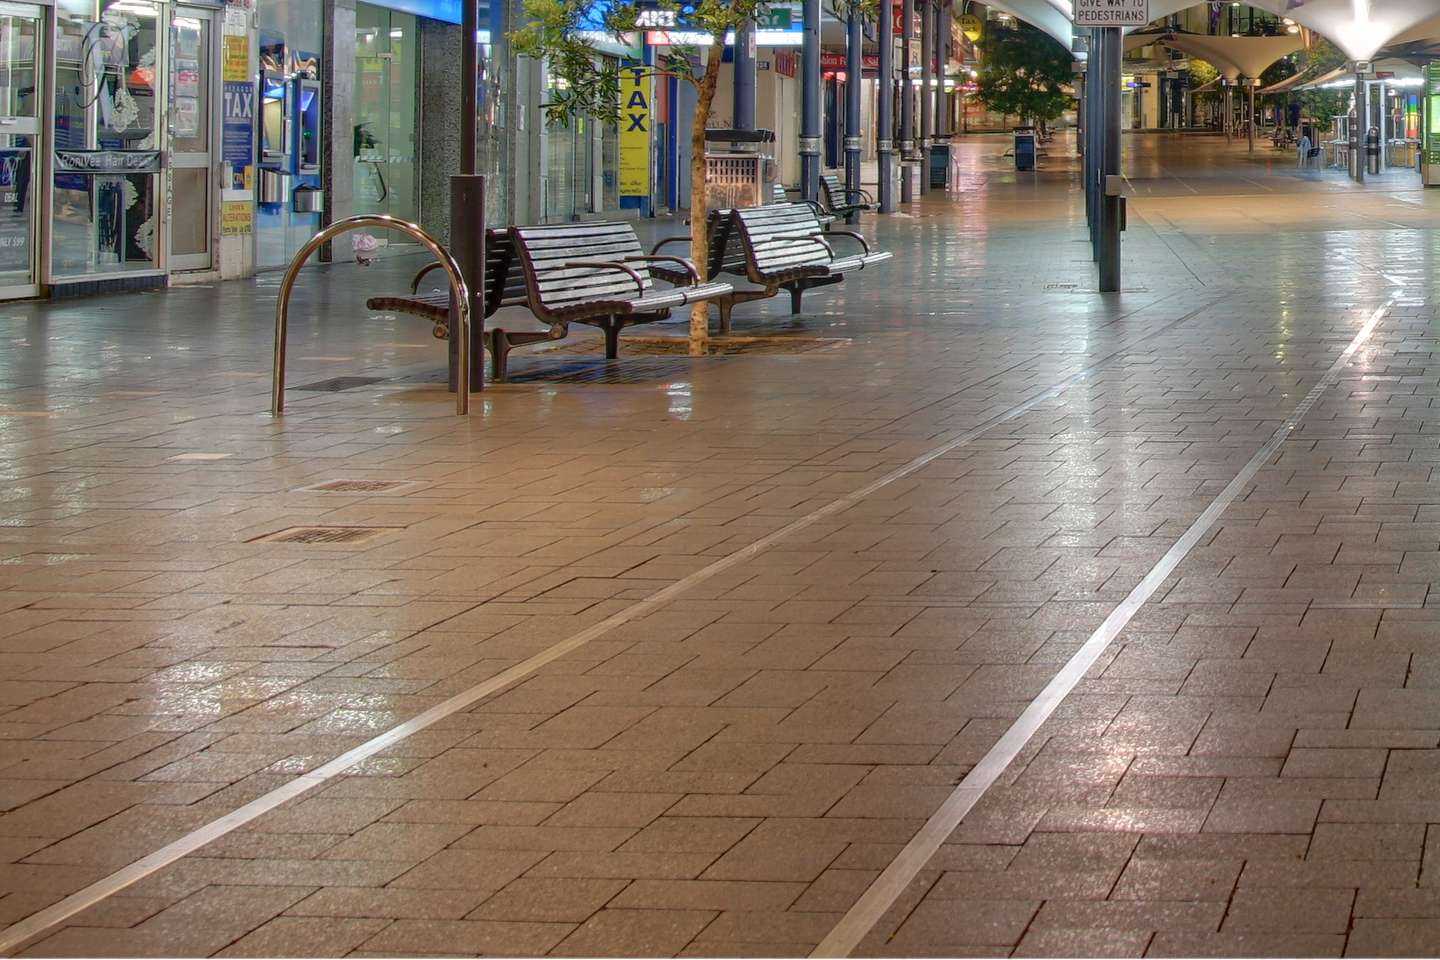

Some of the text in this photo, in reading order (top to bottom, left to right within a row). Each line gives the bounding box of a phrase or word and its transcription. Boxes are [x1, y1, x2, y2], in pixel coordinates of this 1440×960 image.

[635, 10, 675, 27] ANZ
[1079, 10, 1144, 21] PEDESTRIANS
[224, 93, 253, 119] TAX
[627, 68, 649, 133] TAX
